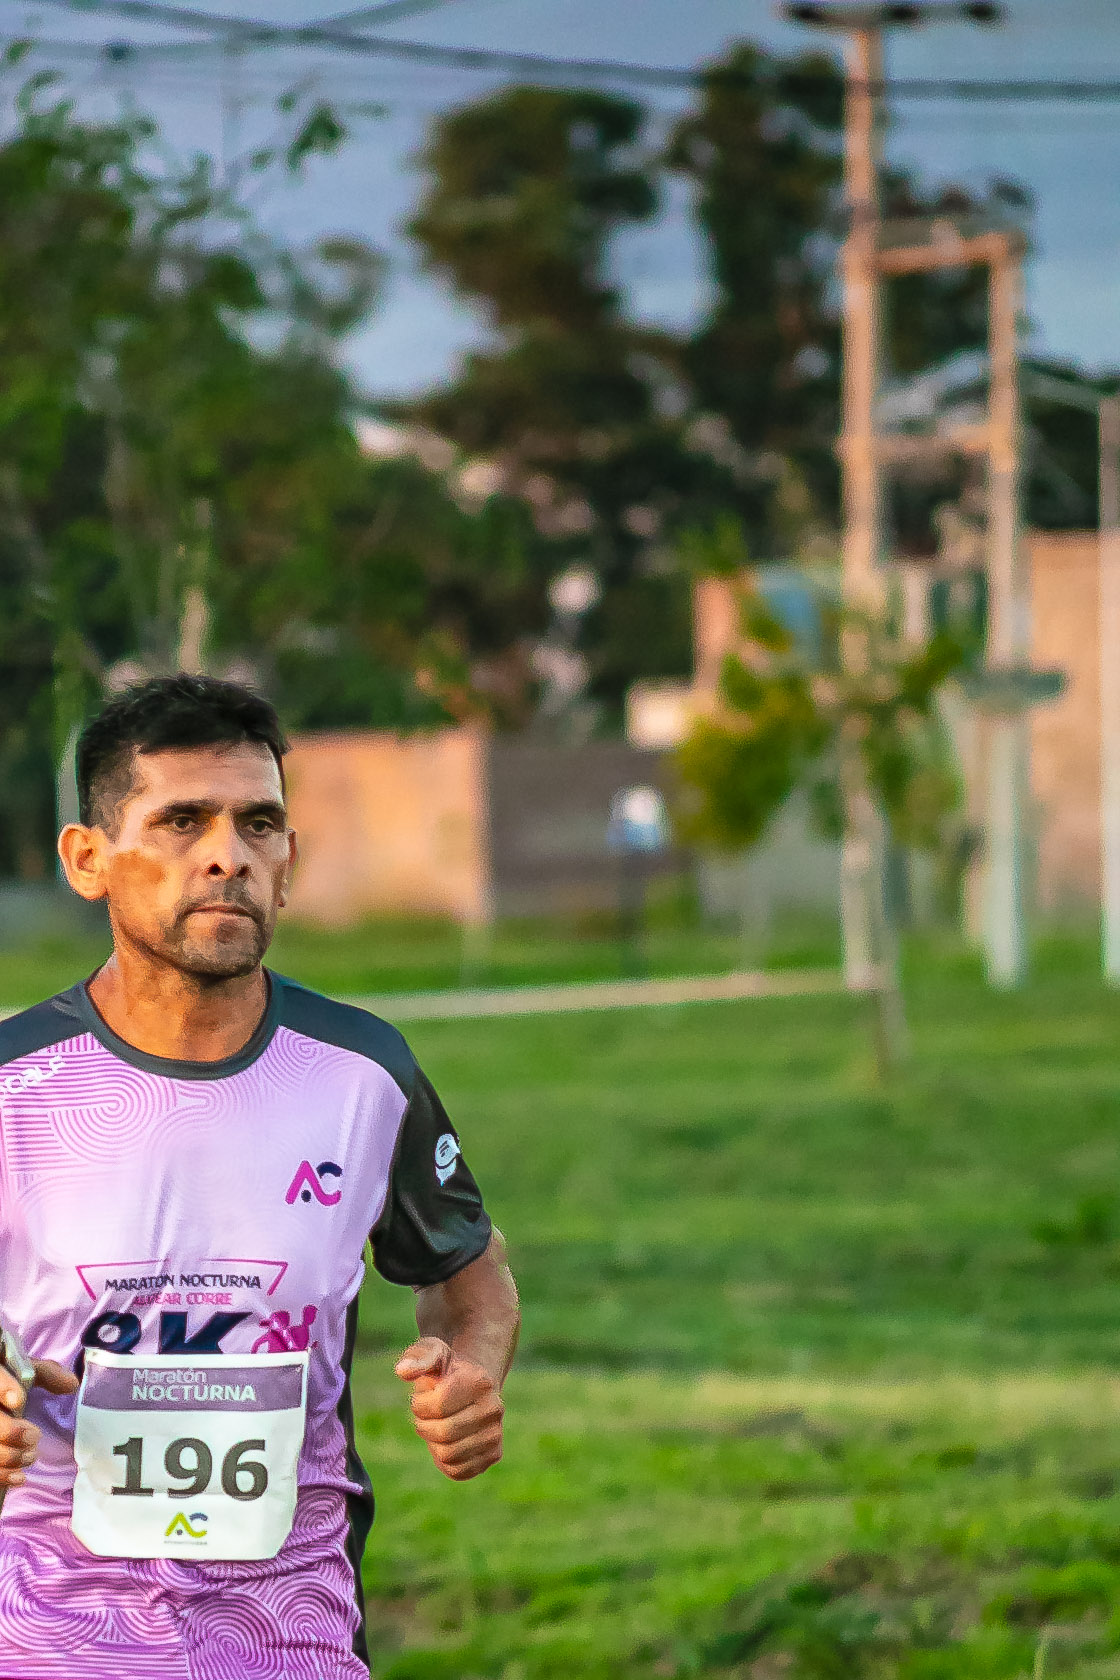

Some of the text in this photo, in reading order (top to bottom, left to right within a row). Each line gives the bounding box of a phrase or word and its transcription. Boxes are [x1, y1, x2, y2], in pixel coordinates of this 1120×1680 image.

[285, 1160, 342, 1206] AC
[179, 1274, 262, 1289] NOCTURNA
[186, 1292, 233, 1306] CORRE
[133, 1368, 207, 1385] Maratón
[131, 1385, 256, 1402] NOCTURNA
[111, 1436, 269, 1502] 196
